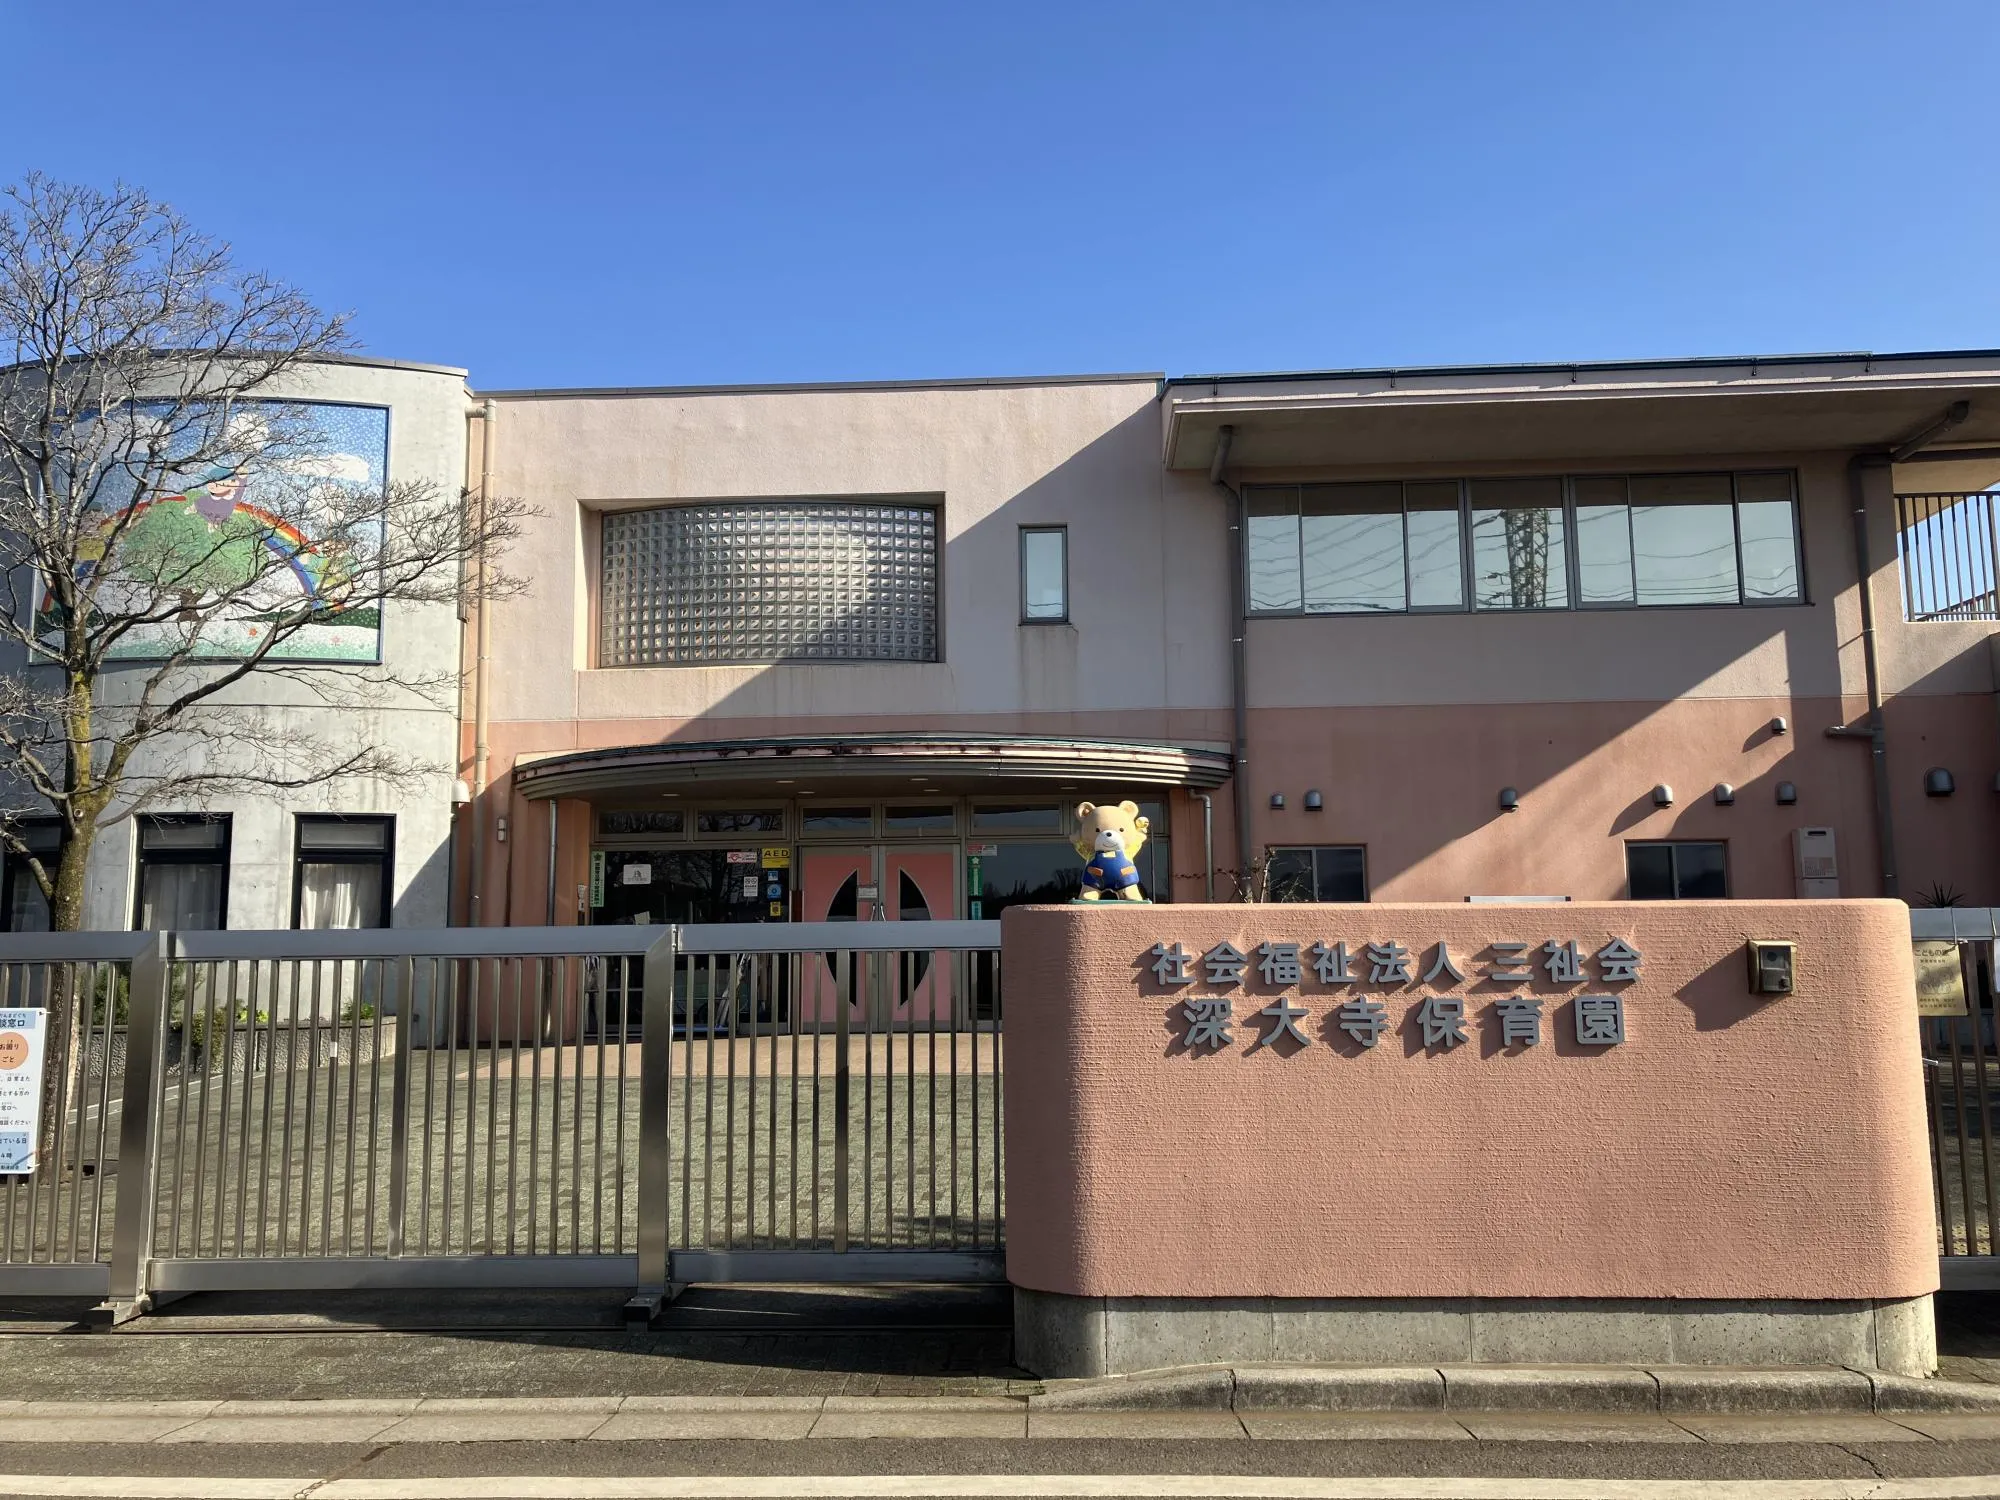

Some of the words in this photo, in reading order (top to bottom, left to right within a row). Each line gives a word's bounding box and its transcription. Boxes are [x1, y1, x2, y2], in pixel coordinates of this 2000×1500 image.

[1151, 939, 1642, 985] 社会福祉法人三祉会
[1914, 949, 1949, 957] こどもの
[1182, 995, 1624, 1048] 深大寺保育園
